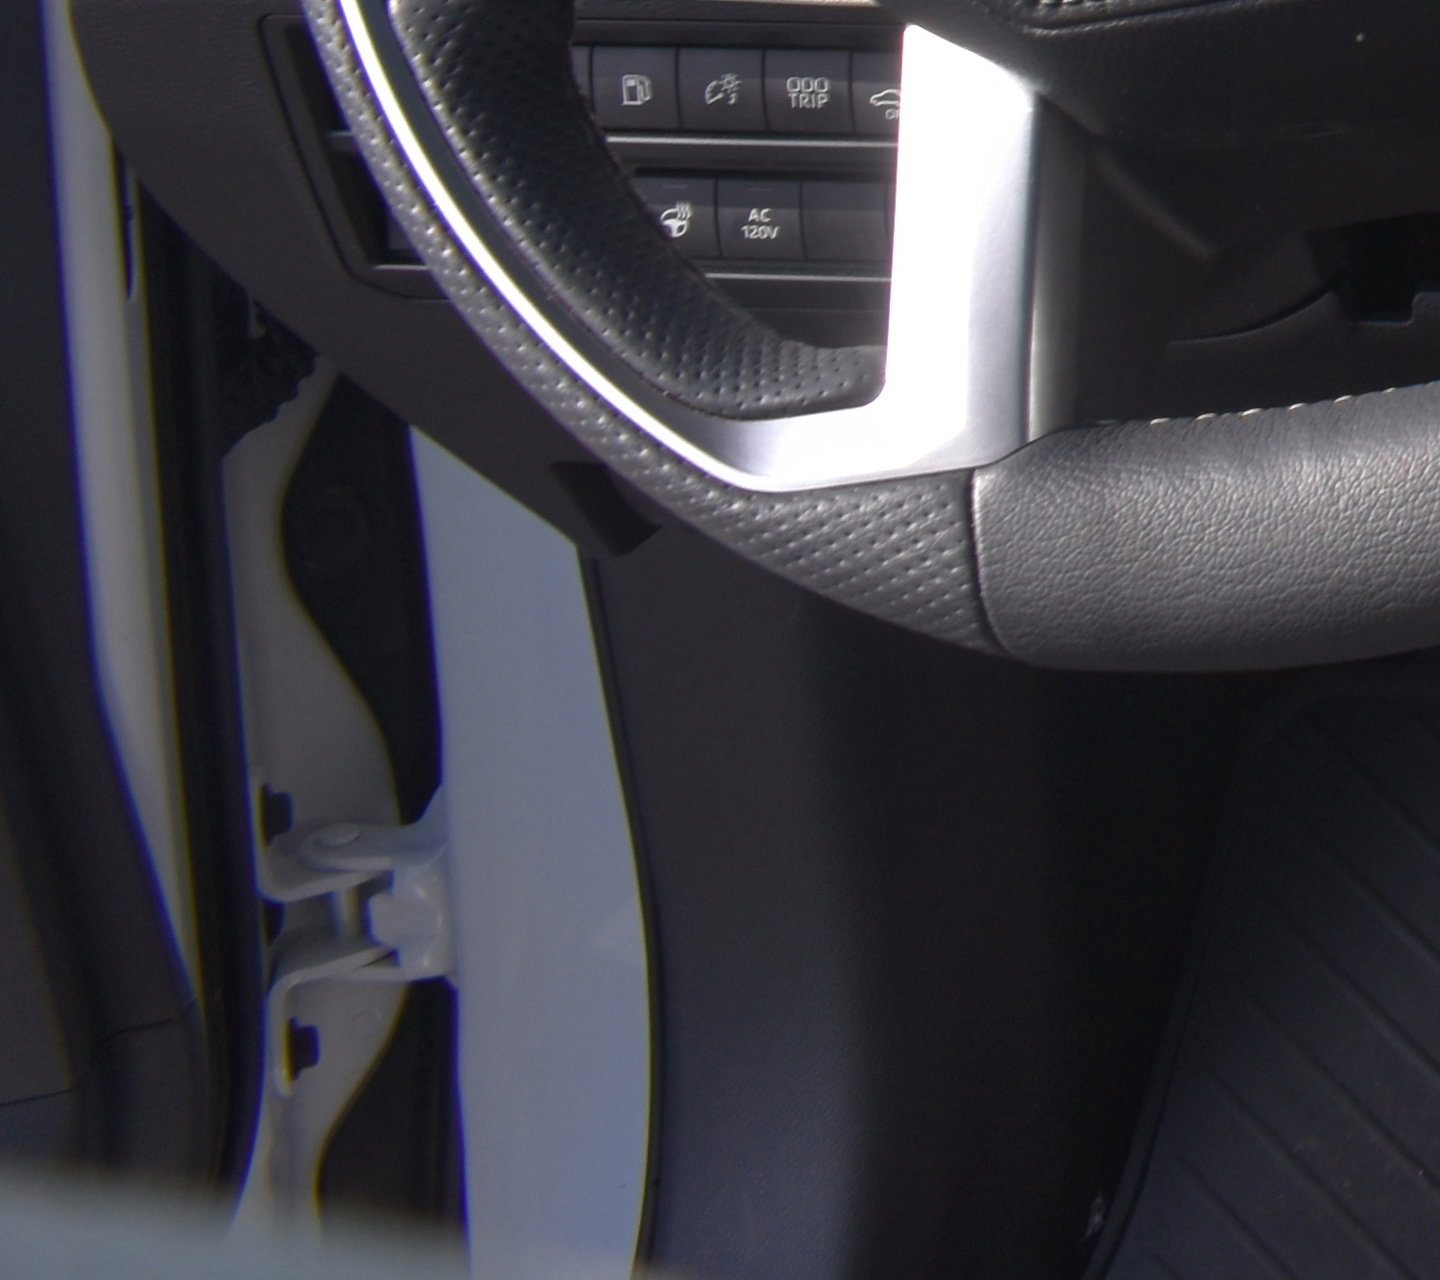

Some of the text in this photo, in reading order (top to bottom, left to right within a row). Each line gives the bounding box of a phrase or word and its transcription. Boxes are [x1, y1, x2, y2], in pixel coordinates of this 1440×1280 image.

[786, 75, 831, 93] ODO
[788, 93, 830, 109] TRIP
[746, 206, 774, 223] AC
[740, 224, 780, 241] 120V
